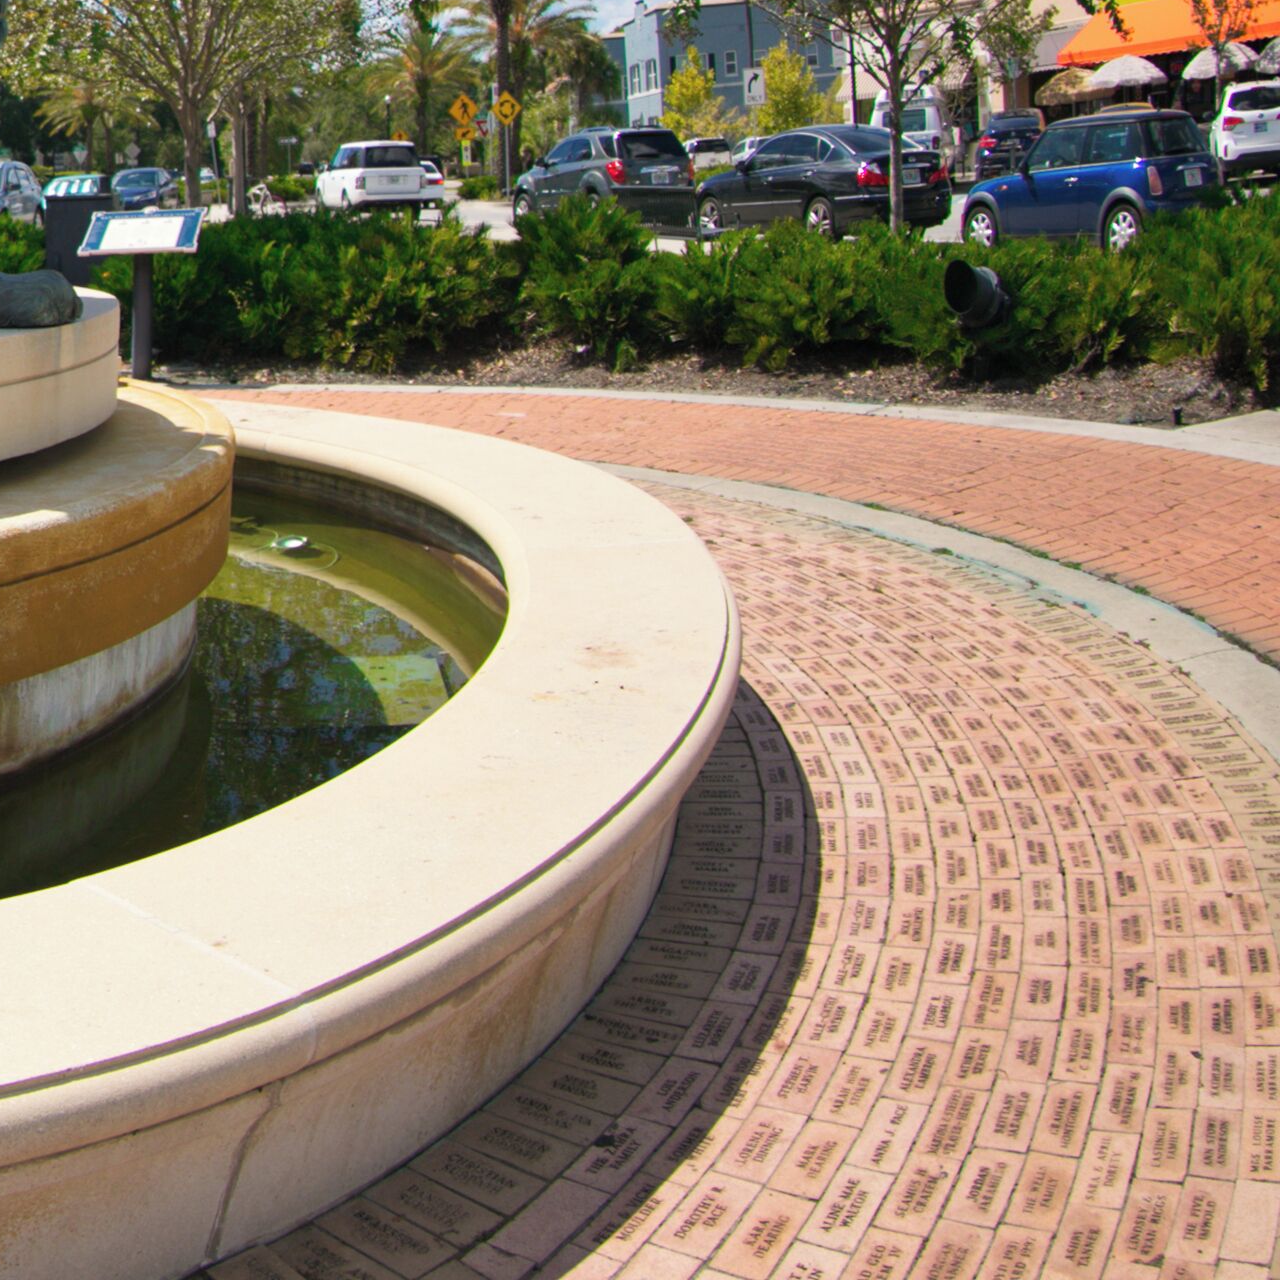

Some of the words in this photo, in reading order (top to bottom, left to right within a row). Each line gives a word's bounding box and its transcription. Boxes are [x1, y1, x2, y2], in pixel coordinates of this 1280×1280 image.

[746, 94, 763, 103] ONLY
[899, 1046, 927, 1091] ALEXANDRA
[661, 1071, 701, 1113] ANDERSON
[609, 1140, 641, 1171] FAMILY
[795, 1143, 820, 1169] MARK
[806, 1140, 838, 1179] DEARING
[1166, 1129, 1180, 1160] FAMILY
[1216, 1120, 1230, 1166] ANDERSON
[1262, 1118, 1277, 1171] PARRAMORE
[966, 1166, 991, 1203] JORDAN
[1039, 1177, 1059, 1208] FAMILY
[615, 1196, 664, 1242] MOULDER
[702, 1204, 728, 1228] PACE
[820, 1202, 845, 1233] ALINE
[838, 1178, 861, 1201] MAE
[839, 1189, 869, 1227] WALTON
[1141, 1229, 1157, 1255] RYAN
[1150, 1194, 1167, 1224] RIGGS
[742, 1219, 770, 1247] KARA
[751, 1215, 791, 1259] DEARING
[1076, 1227, 1101, 1267] TANNER
[1127, 1207, 1147, 1251] LINDSEY
[1183, 1221, 1198, 1241] THE
